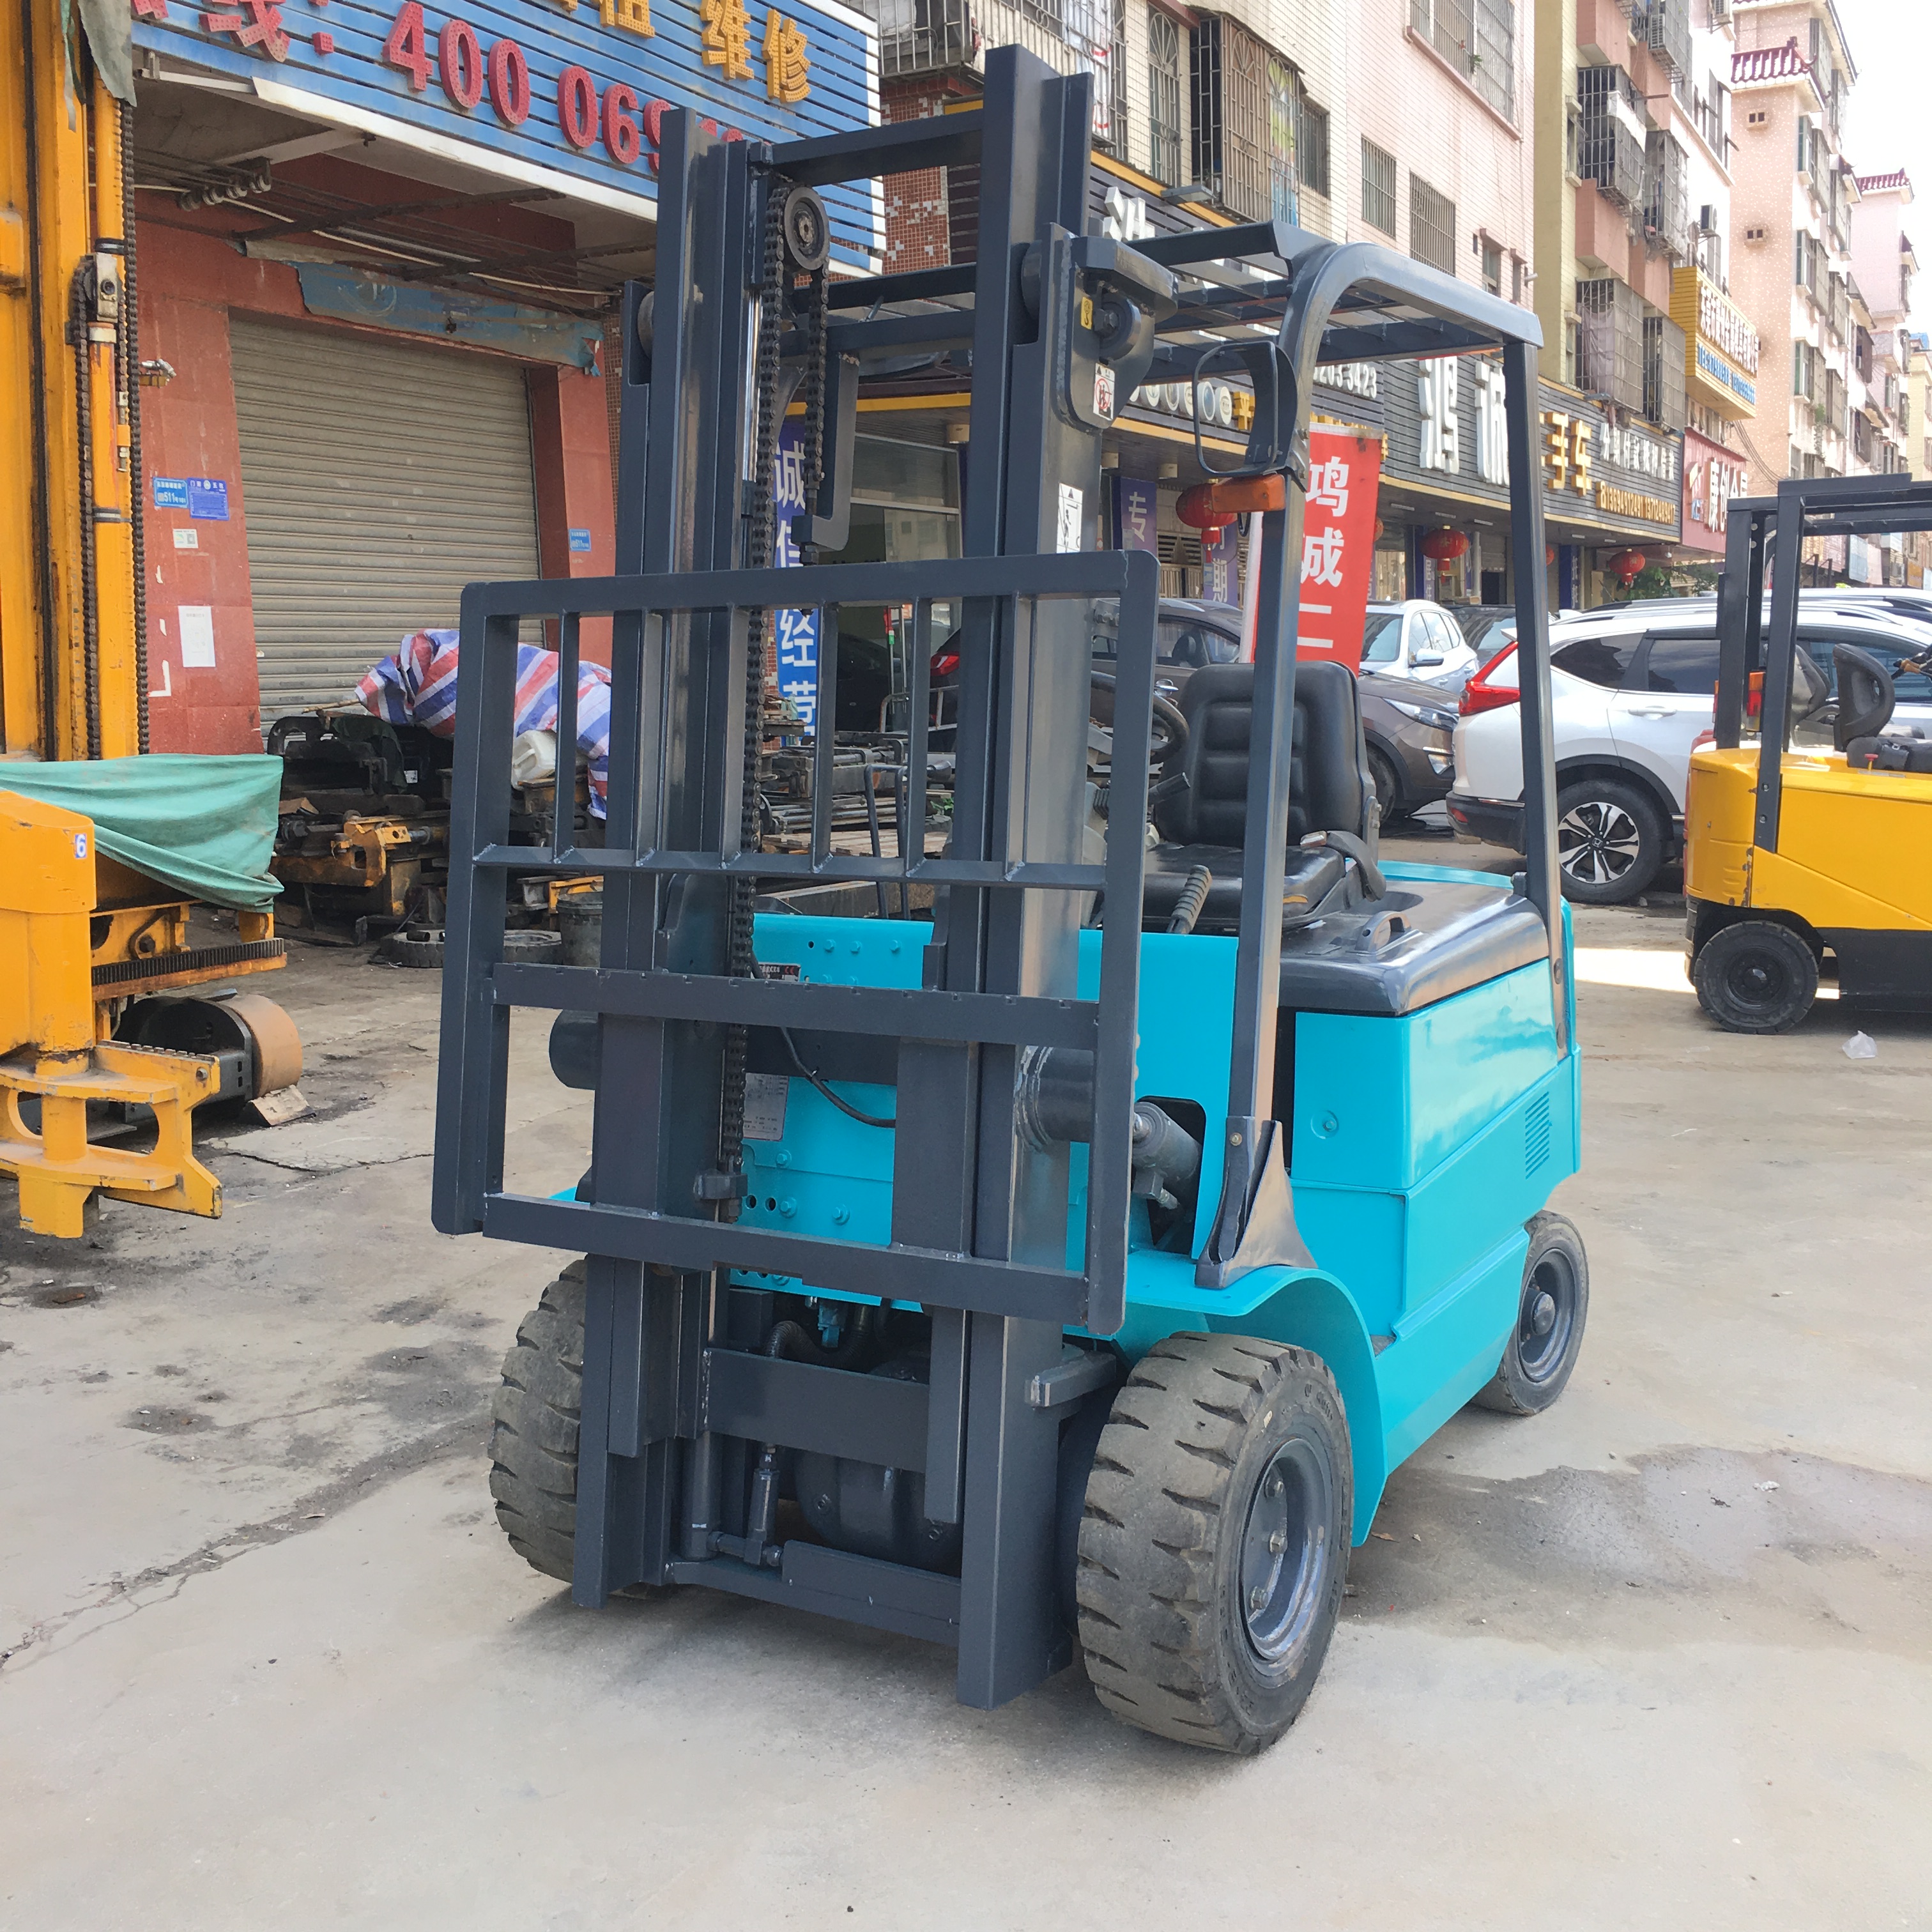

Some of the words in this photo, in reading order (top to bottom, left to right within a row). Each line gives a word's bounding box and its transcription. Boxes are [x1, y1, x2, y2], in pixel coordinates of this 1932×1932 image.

[383, 1, 531, 126] 400
[700, 0, 811, 103] 维修
[1128, 491, 1147, 542] 专
[77, 834, 86, 857] 6
